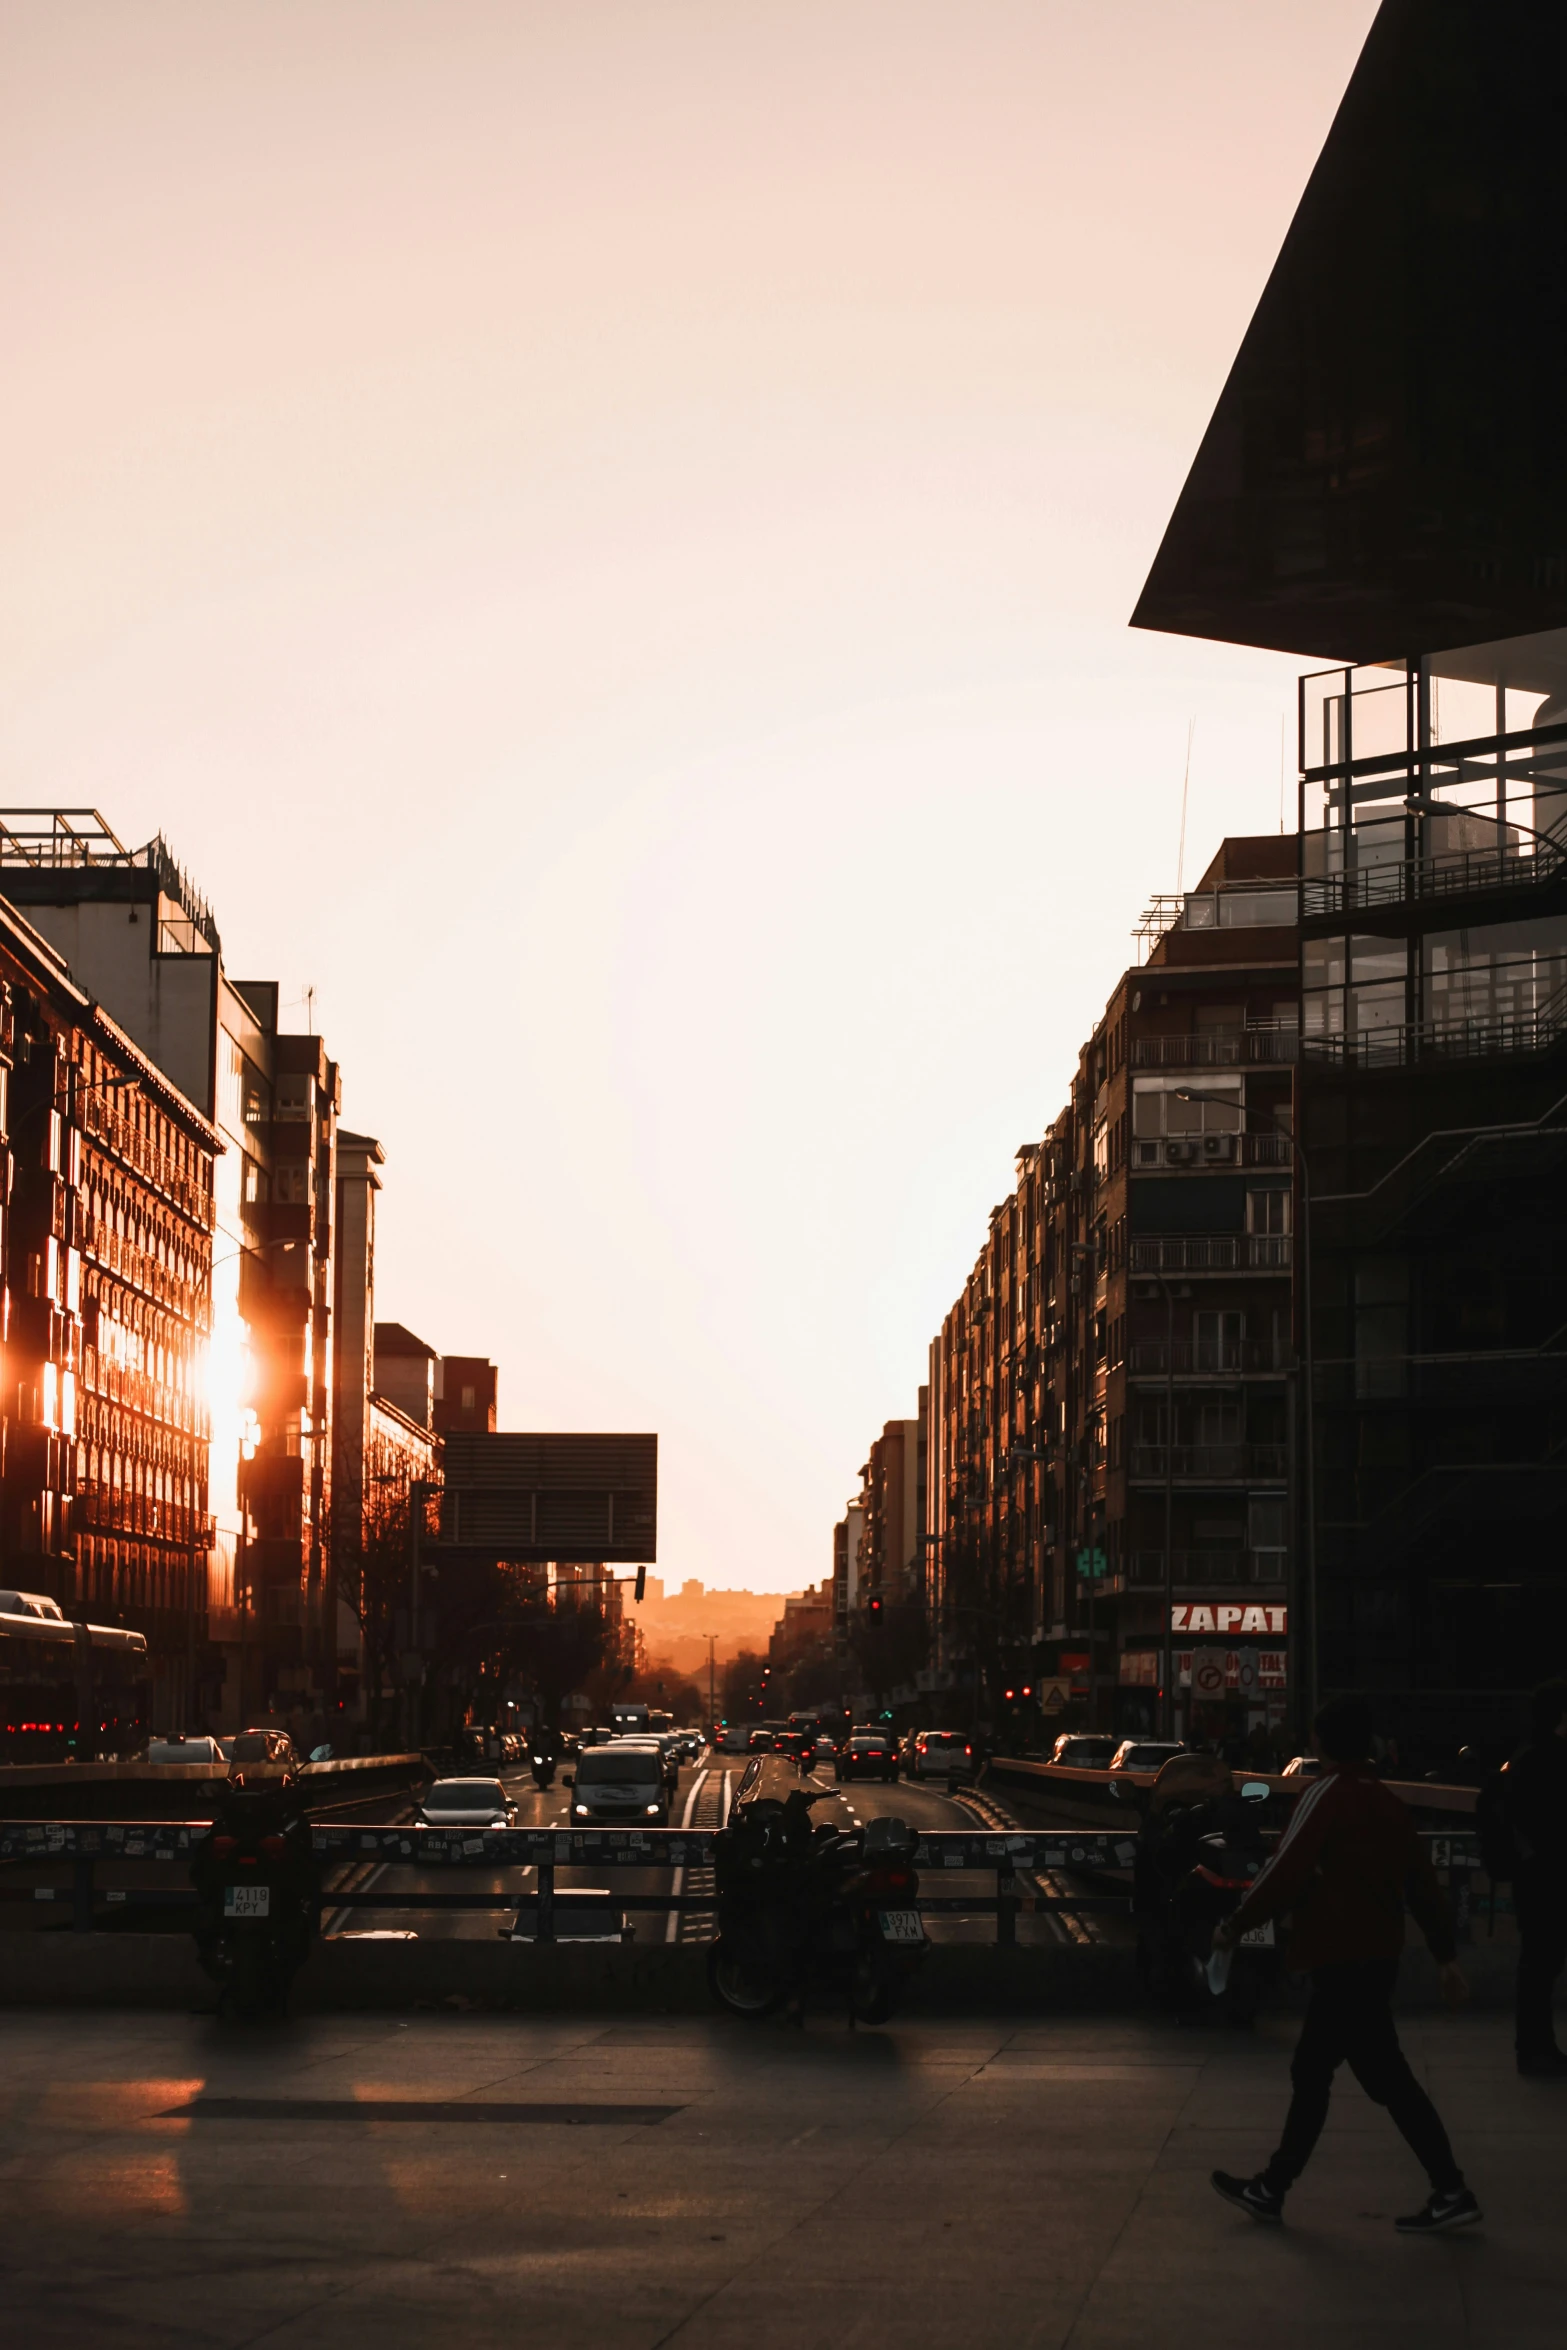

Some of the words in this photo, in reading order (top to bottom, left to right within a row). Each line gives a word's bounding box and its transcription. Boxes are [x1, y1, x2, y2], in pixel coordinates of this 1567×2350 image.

[1171, 1606, 1287, 1632] ZAPAT
[427, 1840, 448, 1850] RBA
[235, 1889, 267, 1902] 4119
[235, 1902, 259, 1915] KPY
[888, 1912, 917, 1926] 3971
[895, 1925, 919, 1938] FXM
